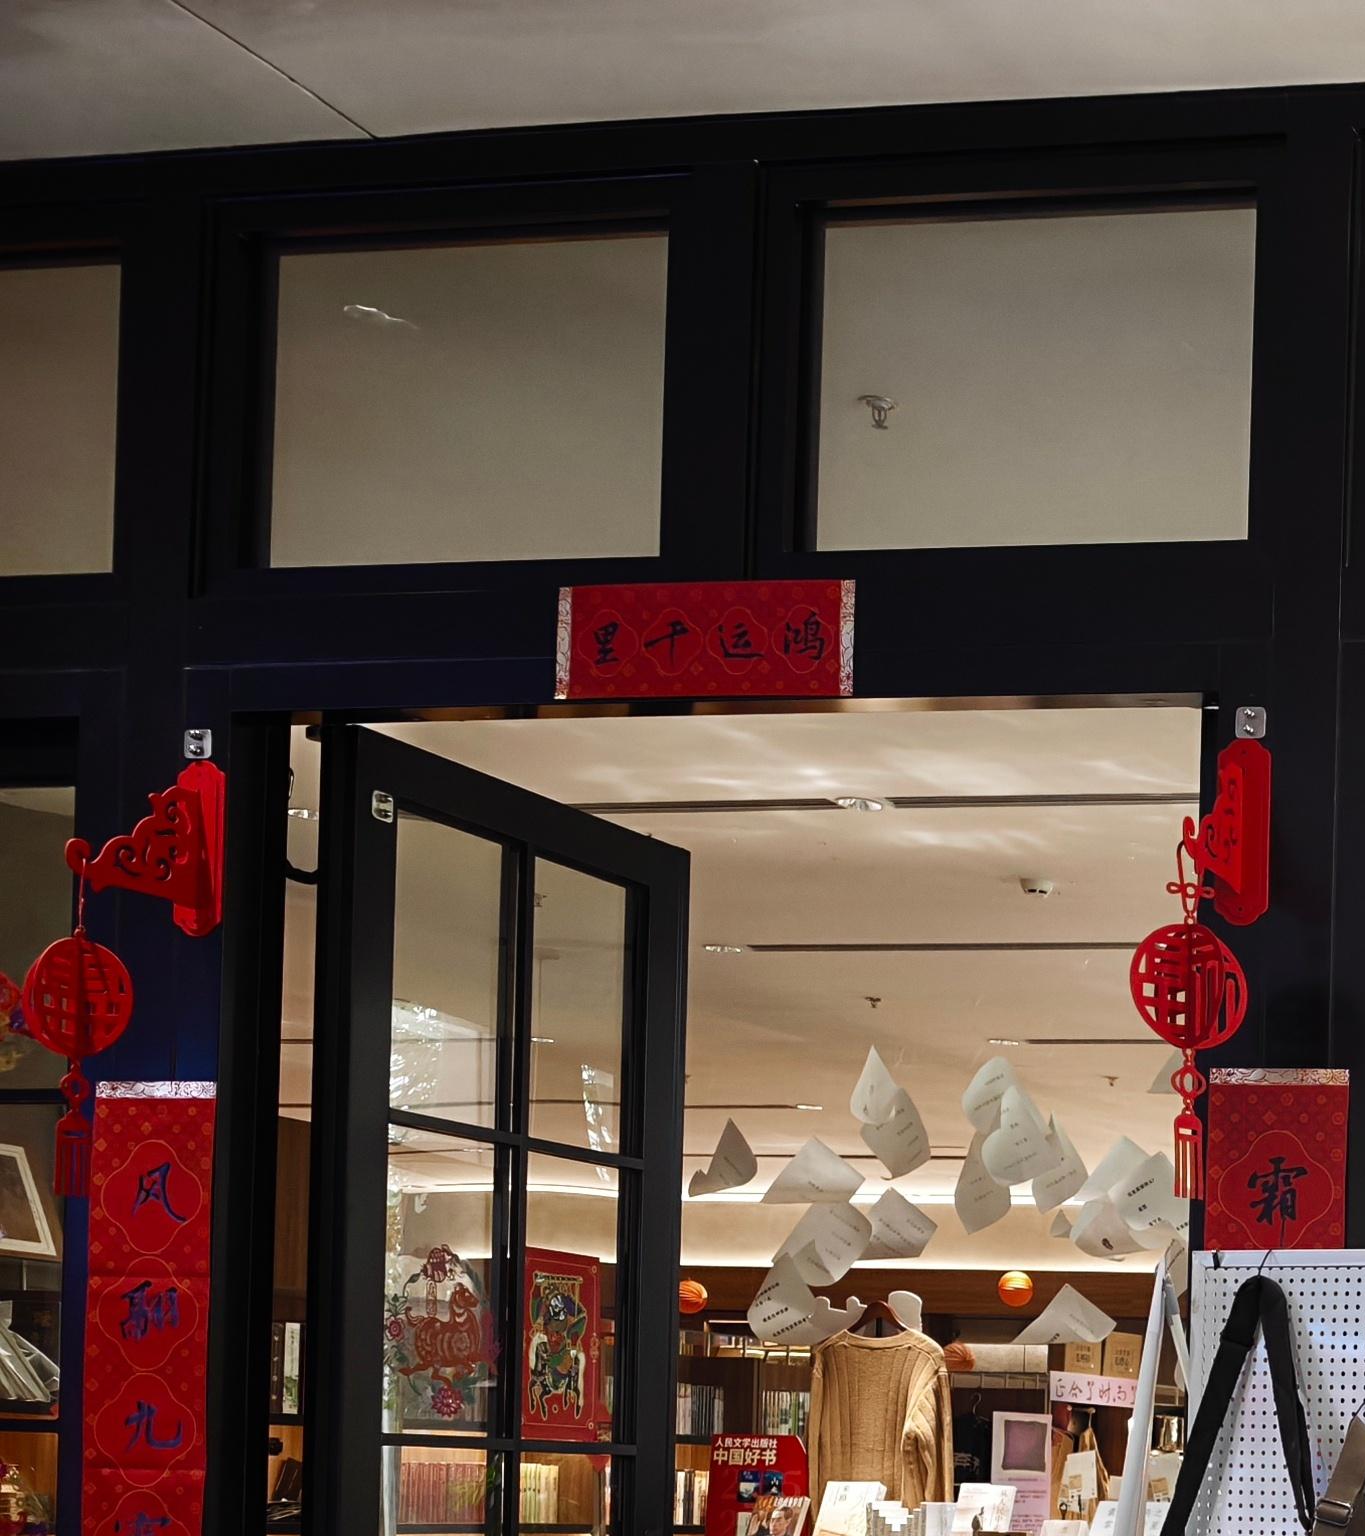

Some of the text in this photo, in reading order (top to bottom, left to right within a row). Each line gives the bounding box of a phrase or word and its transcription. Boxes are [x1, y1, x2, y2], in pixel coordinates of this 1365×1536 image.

[1248, 1156, 1308, 1246] 霜
[715, 1437, 777, 1448] 人民文学出版社
[713, 1448, 777, 1466] 中国好书
